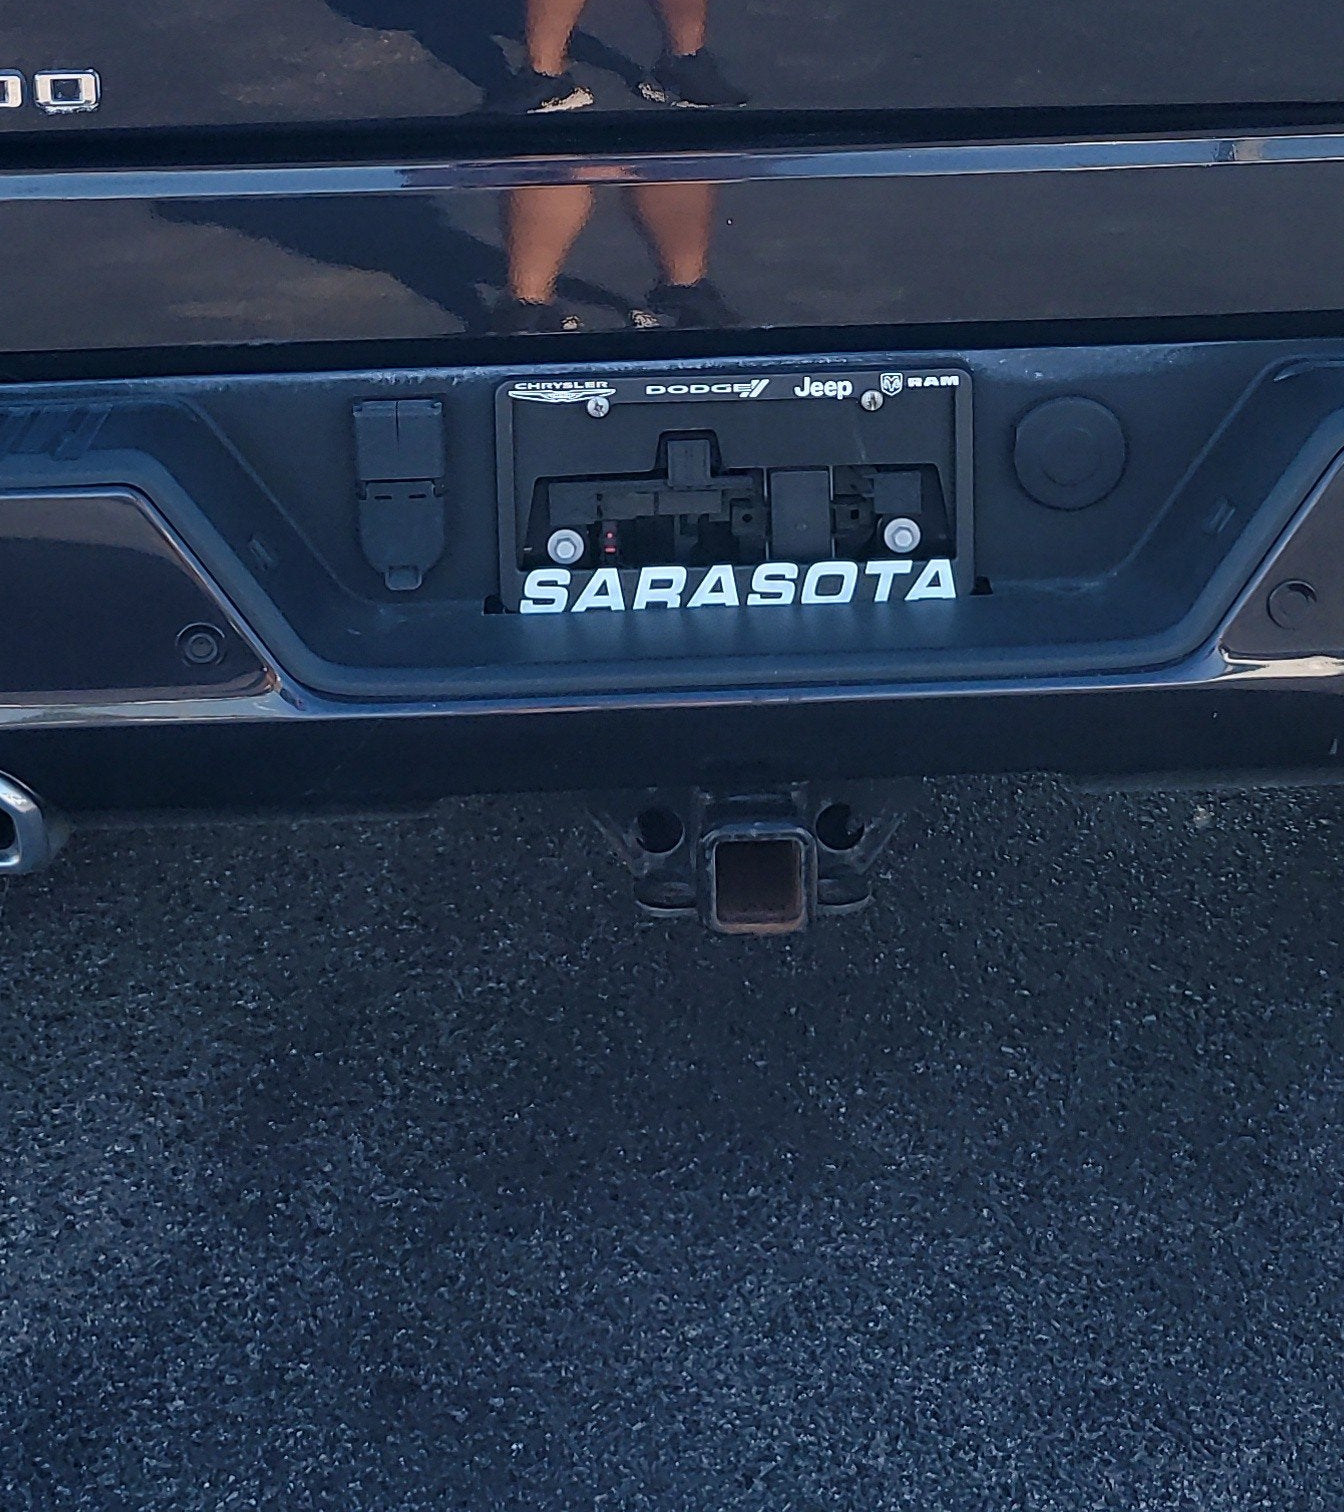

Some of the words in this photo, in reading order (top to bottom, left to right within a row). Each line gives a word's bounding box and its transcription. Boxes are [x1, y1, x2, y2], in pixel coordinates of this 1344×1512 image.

[513, 381, 609, 391] CHRYSLER
[645, 382, 753, 397] DODGE
[794, 376, 853, 400] Jeep
[906, 374, 960, 388] RAM
[518, 558, 958, 615] SARASOTA
